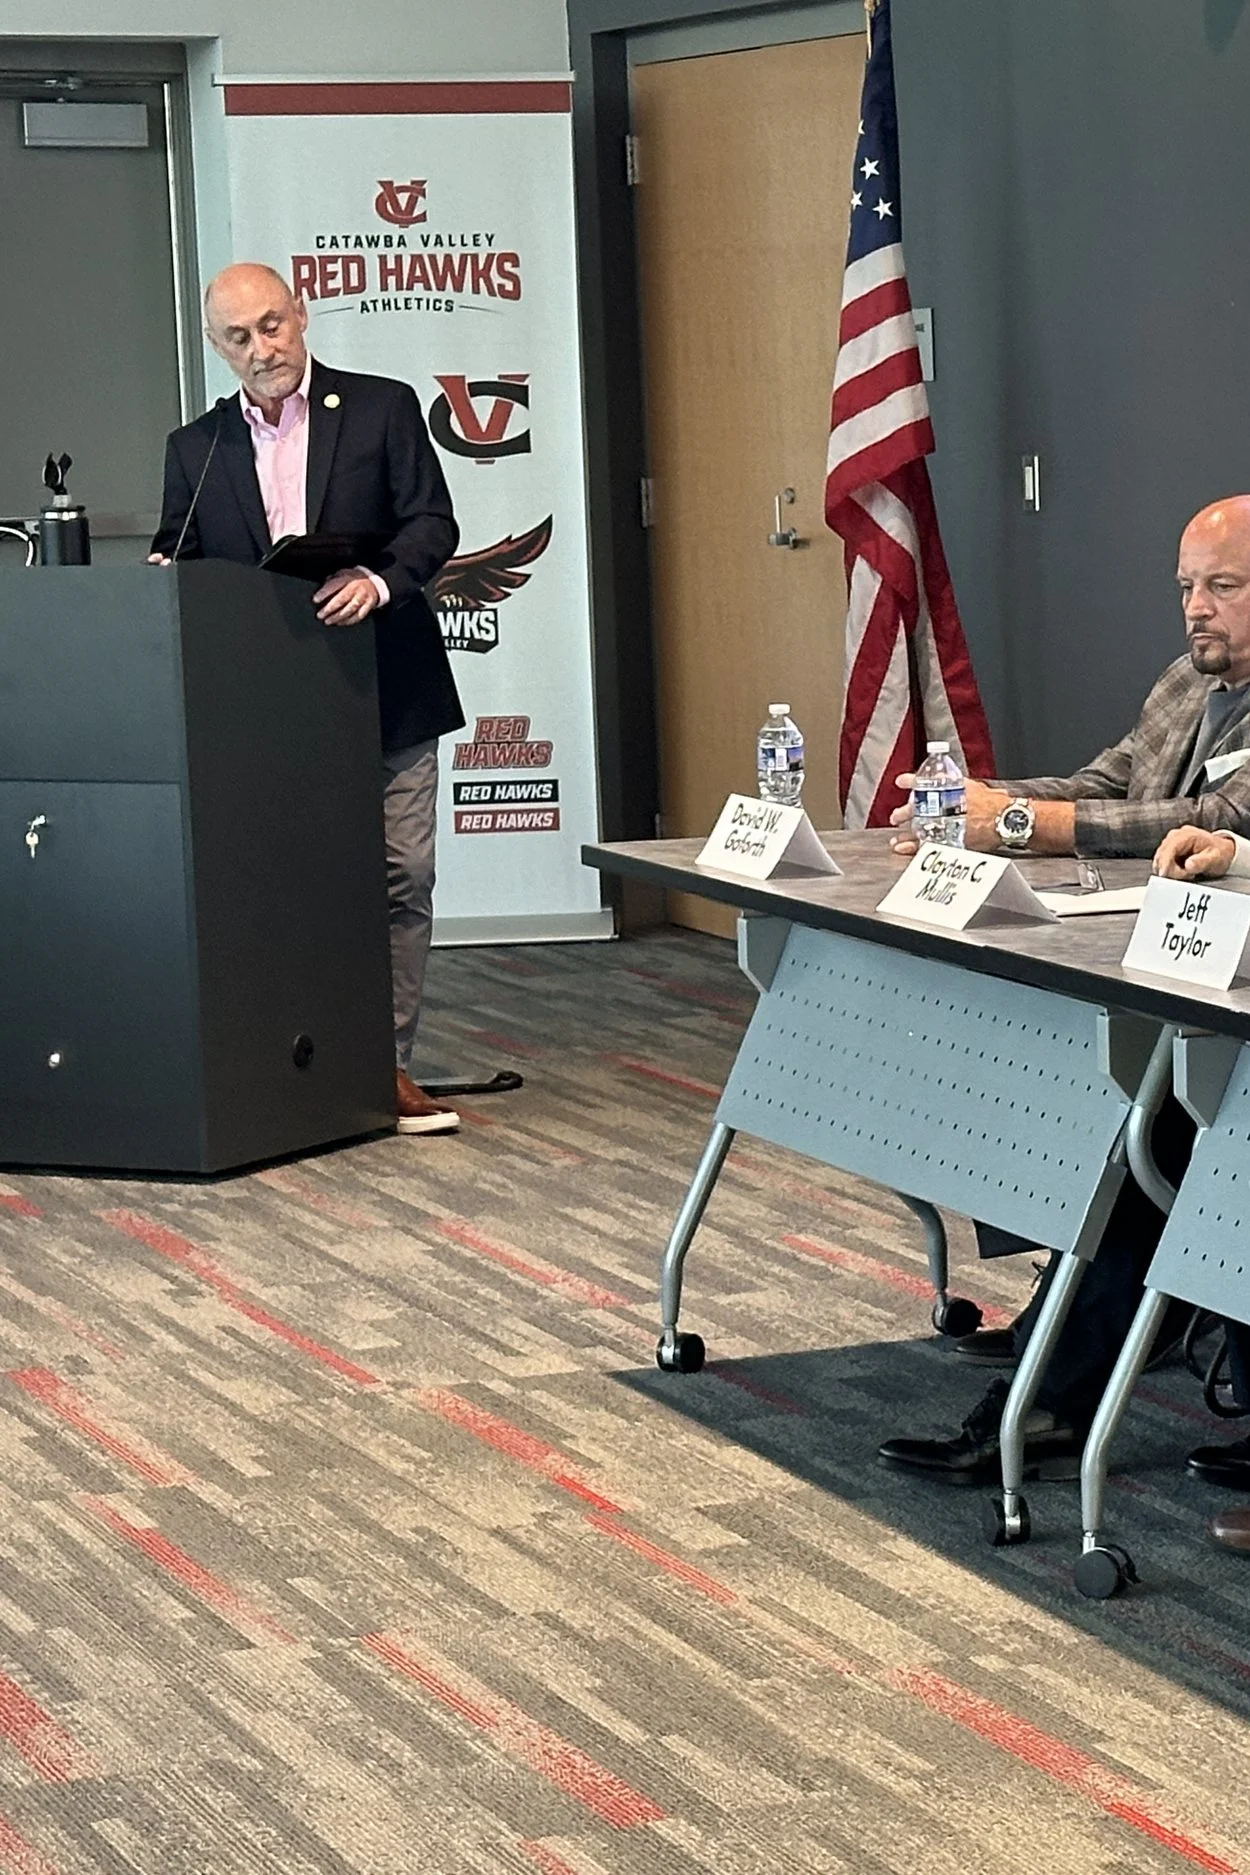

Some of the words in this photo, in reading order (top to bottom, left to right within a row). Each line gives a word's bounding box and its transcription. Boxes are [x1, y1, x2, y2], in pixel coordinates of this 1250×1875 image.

[316, 235, 408, 249] CATAWBA
[420, 233, 496, 248] VALLEY
[290, 254, 367, 302] RED
[377, 251, 523, 302] HAWKS
[360, 297, 455, 314] ATHLETICS
[436, 610, 497, 642] WKS
[475, 716, 530, 742] RED
[454, 741, 553, 769] HAWKS
[460, 786, 491, 801] RED
[494, 784, 553, 800] HAWKS
[461, 814, 493, 829] RED
[496, 812, 554, 829] HAWKS
[731, 803, 768, 829] David
[764, 811, 783, 834] W.
[921, 850, 970, 880] Clayton
[915, 878, 957, 905] Mullis
[1178, 892, 1211, 924] Jeff
[1161, 922, 1212, 961] Taylor
